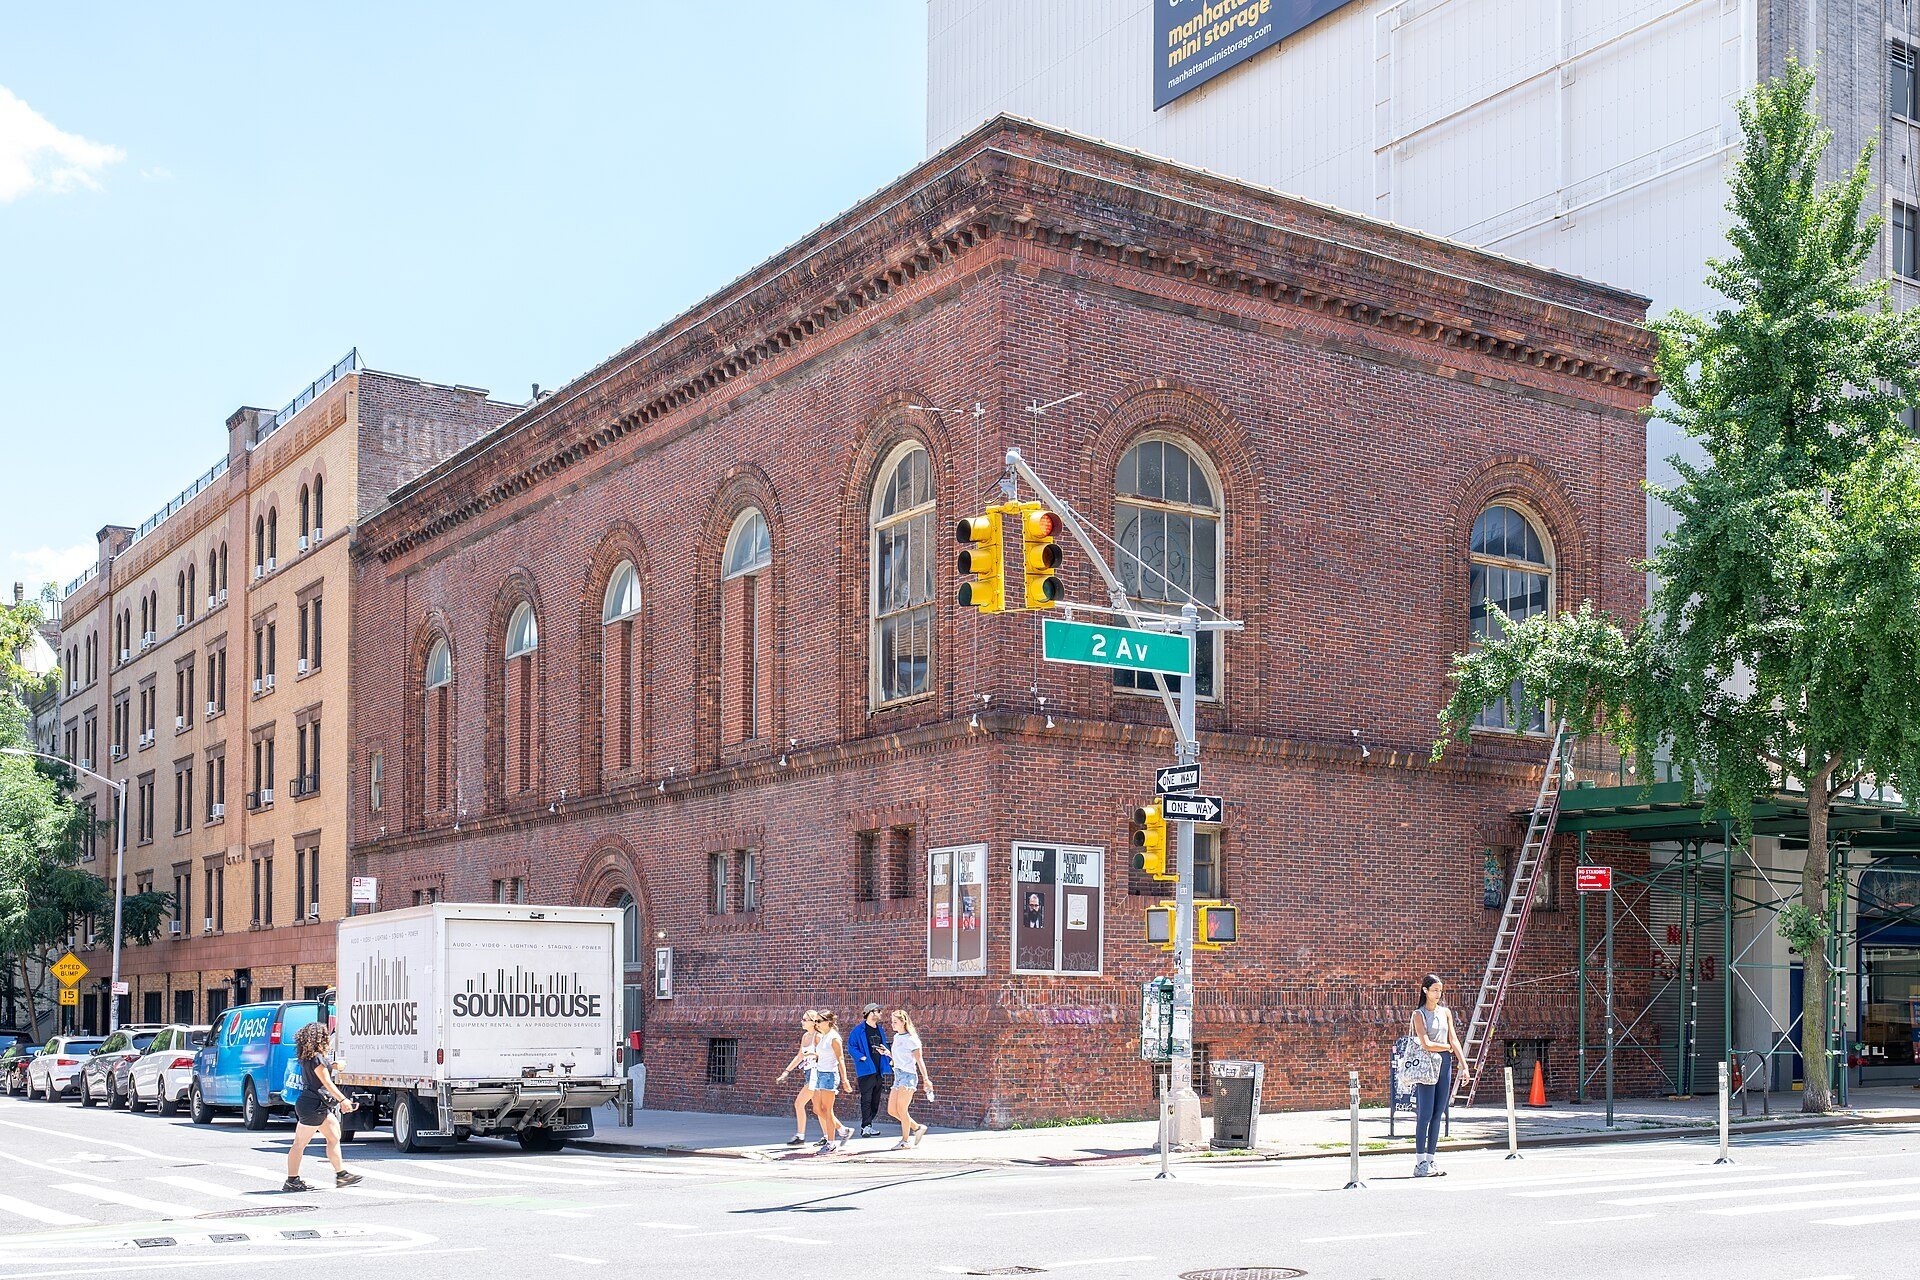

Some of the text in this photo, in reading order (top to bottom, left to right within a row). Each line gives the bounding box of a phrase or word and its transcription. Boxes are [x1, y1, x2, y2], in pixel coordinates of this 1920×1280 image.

[1168, 31, 1201, 68] mini
[1168, 23, 1272, 88] manhattanministorage.com
[1091, 634, 1148, 661] 2 Av
[1162, 772, 1195, 786] ONE WAY
[1171, 802, 1213, 815] ONE WAY
[1062, 853, 1088, 865] ANTHOLOGY
[1066, 863, 1077, 874] FILM
[1063, 873, 1084, 884] ARCHIVES
[452, 993, 601, 1018] SOUNDHOUSE
[237, 1012, 270, 1045] pepsi
[350, 1001, 418, 1036] SOUNDHOUSE
